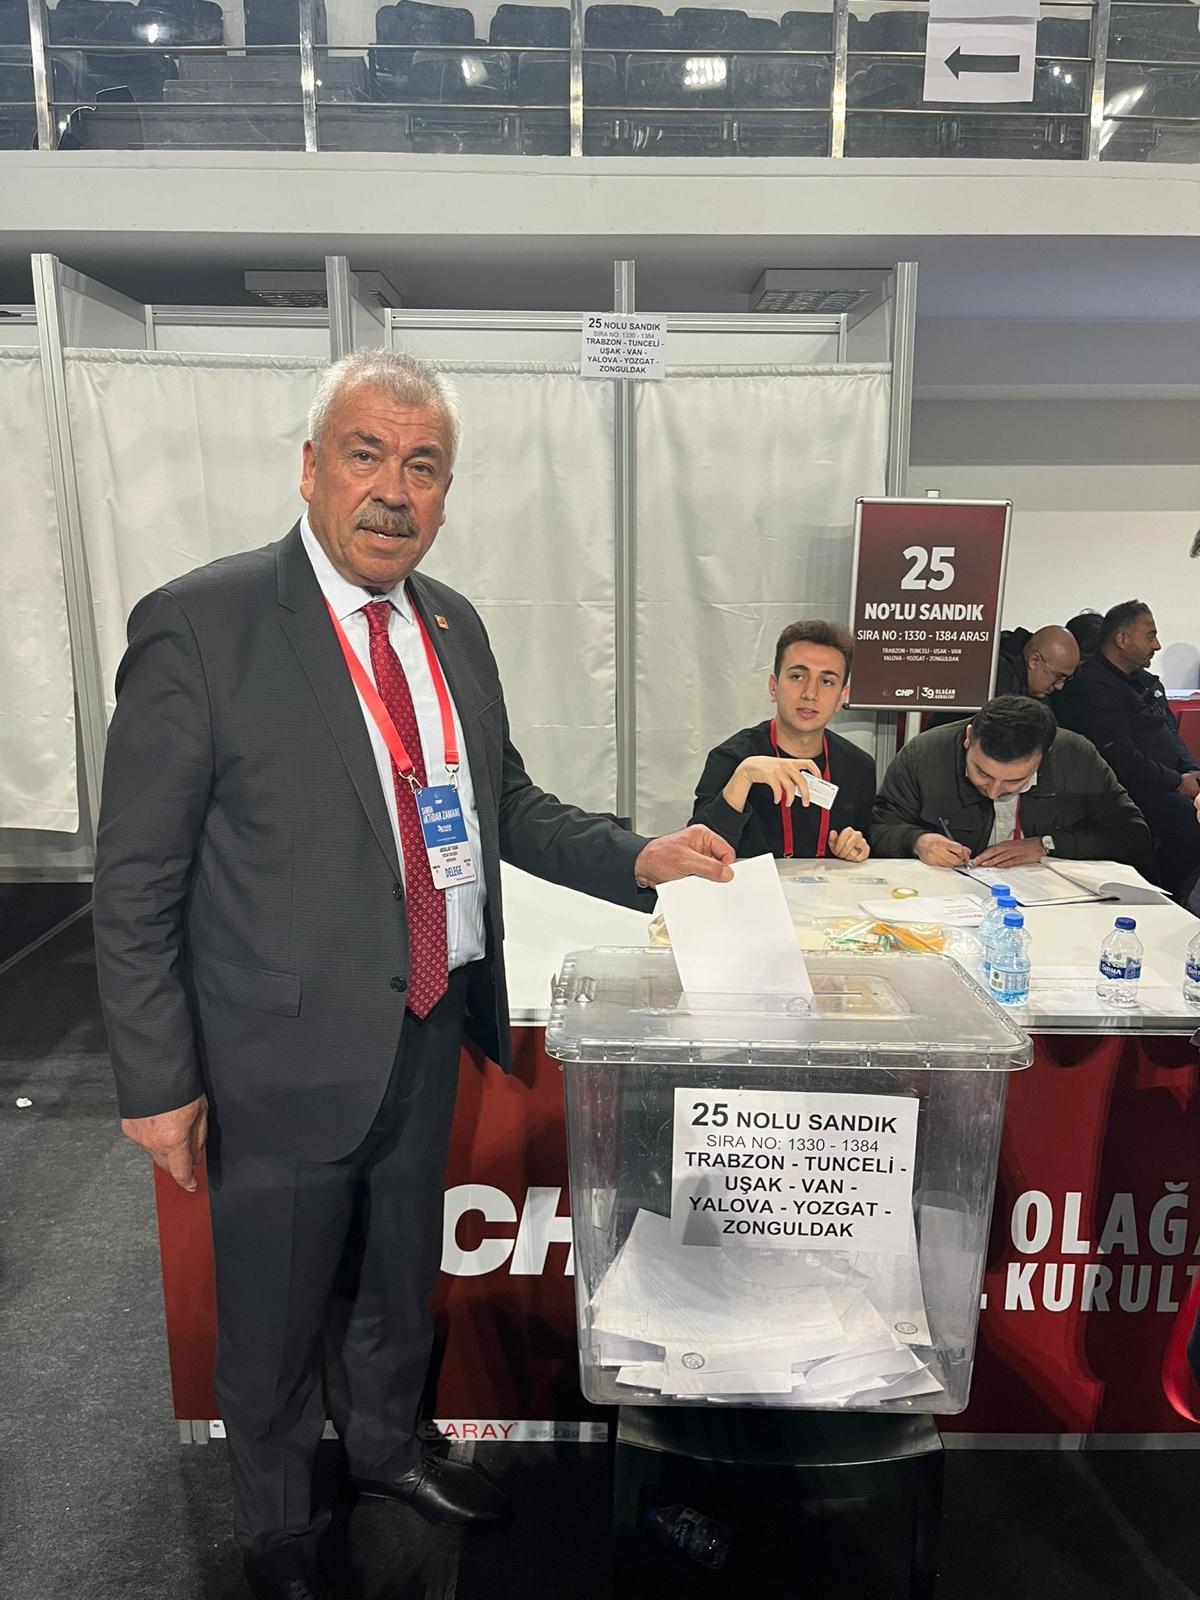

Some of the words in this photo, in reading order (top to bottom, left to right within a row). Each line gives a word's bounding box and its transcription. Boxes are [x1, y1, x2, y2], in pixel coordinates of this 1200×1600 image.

[588, 317, 602, 328] 25
[604, 322, 627, 330] NOLU
[629, 323, 660, 331] SANDIK
[628, 339, 659, 347] TUNCELİ
[599, 365, 646, 373] ZONGULDAK
[624, 357, 654, 365] YOZGAT
[900, 545, 955, 591] 25
[864, 603, 916, 620] NO'LU
[919, 604, 984, 621] SANDIK
[857, 630, 880, 640] SIRA
[882, 631, 896, 640] NO
[904, 631, 926, 641] 1330
[935, 631, 957, 641] 1384
[959, 631, 989, 641] ARASI
[691, 1102, 729, 1127] 25
[737, 1112, 800, 1130] NOLU
[808, 1115, 897, 1133] SANDIK
[706, 1135, 746, 1149] SIRA
[752, 1137, 781, 1150] NO:
[788, 1139, 825, 1151] 1330
[842, 1140, 878, 1152] 1384
[685, 1152, 785, 1170] TRABZON
[805, 1156, 894, 1174] TUNCELİ
[725, 1176, 782, 1195] UŞAK
[801, 1179, 844, 1193] VAN
[689, 1197, 773, 1214] YALOVA
[793, 1200, 878, 1216] YOZGAT
[1011, 1181, 1200, 1256] OLAĞ
[722, 1220, 853, 1237] ZONGULDAK
[425, 1423, 514, 1439] SARAY
